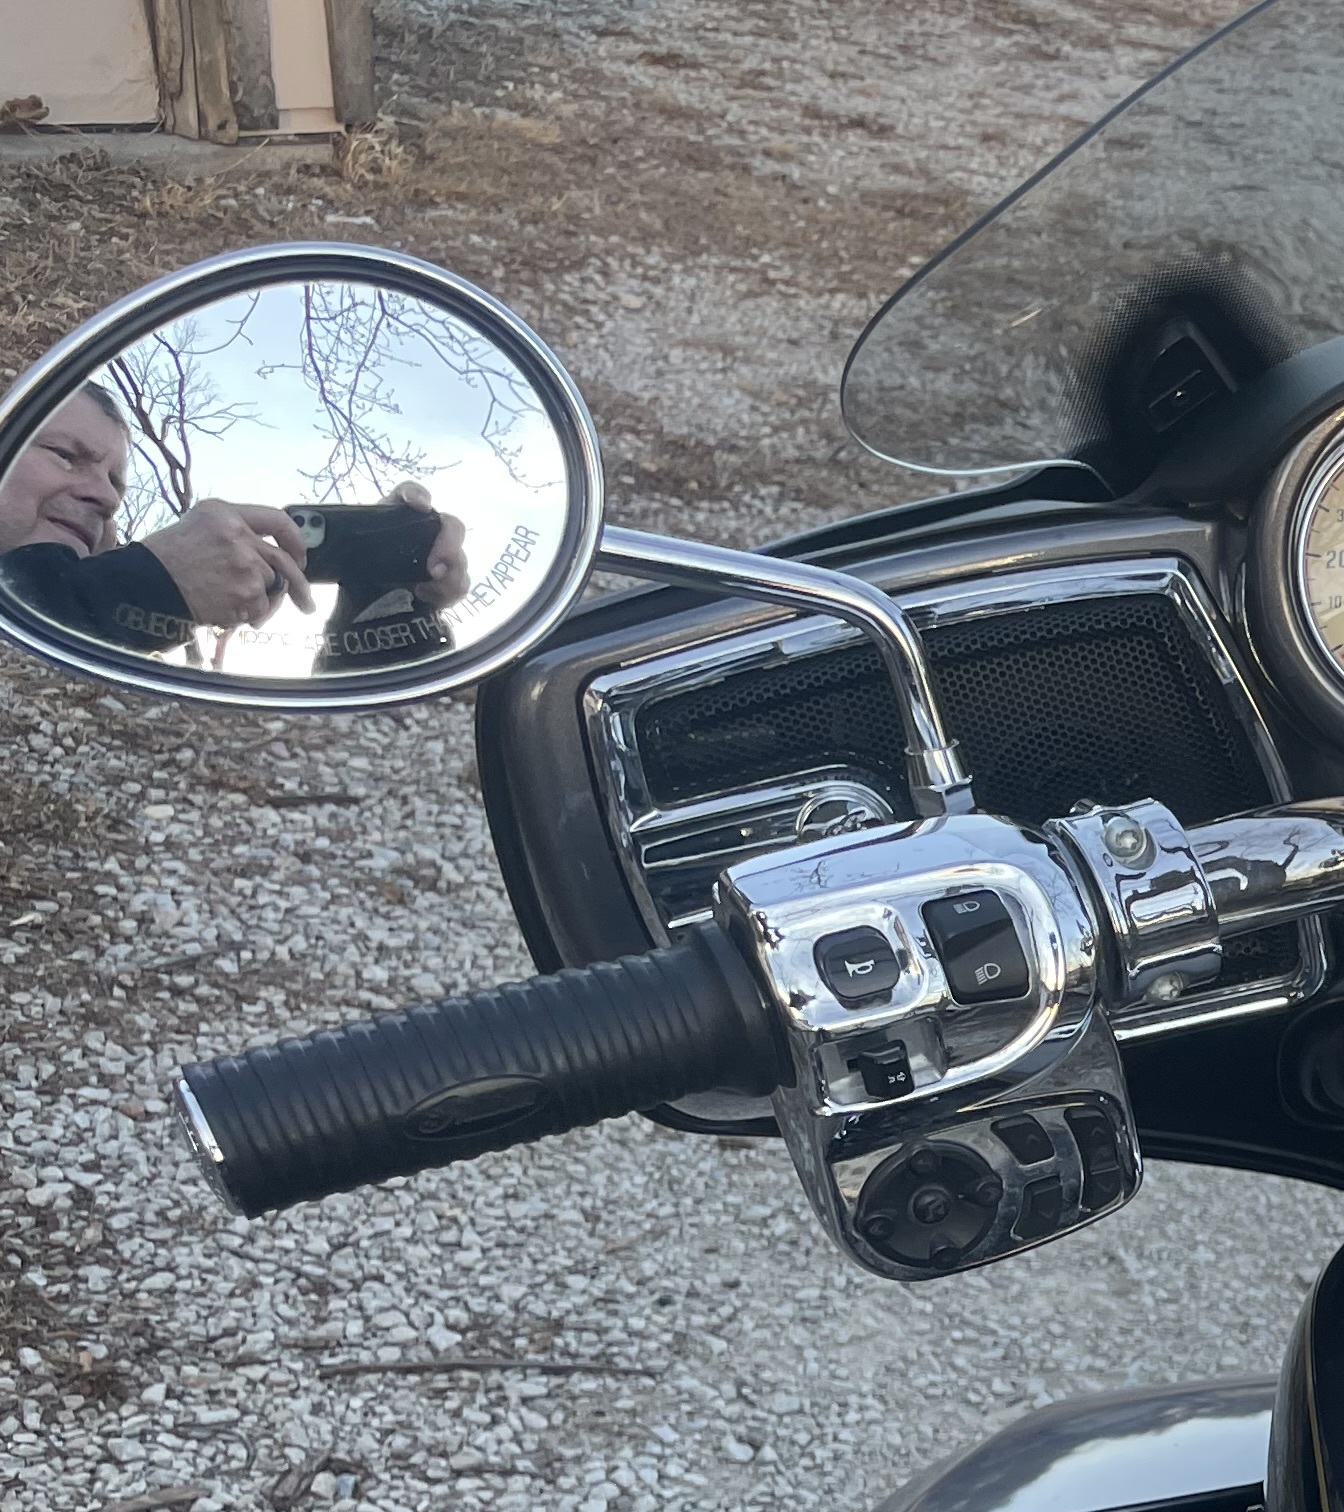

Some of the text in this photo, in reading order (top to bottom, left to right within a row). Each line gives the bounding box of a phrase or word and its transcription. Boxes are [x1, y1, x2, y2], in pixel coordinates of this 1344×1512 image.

[343, 623, 416, 656] CLOSER
[457, 576, 502, 617] THEY
[490, 525, 540, 590] APPEAR
[1329, 595, 1343, 609] 10
